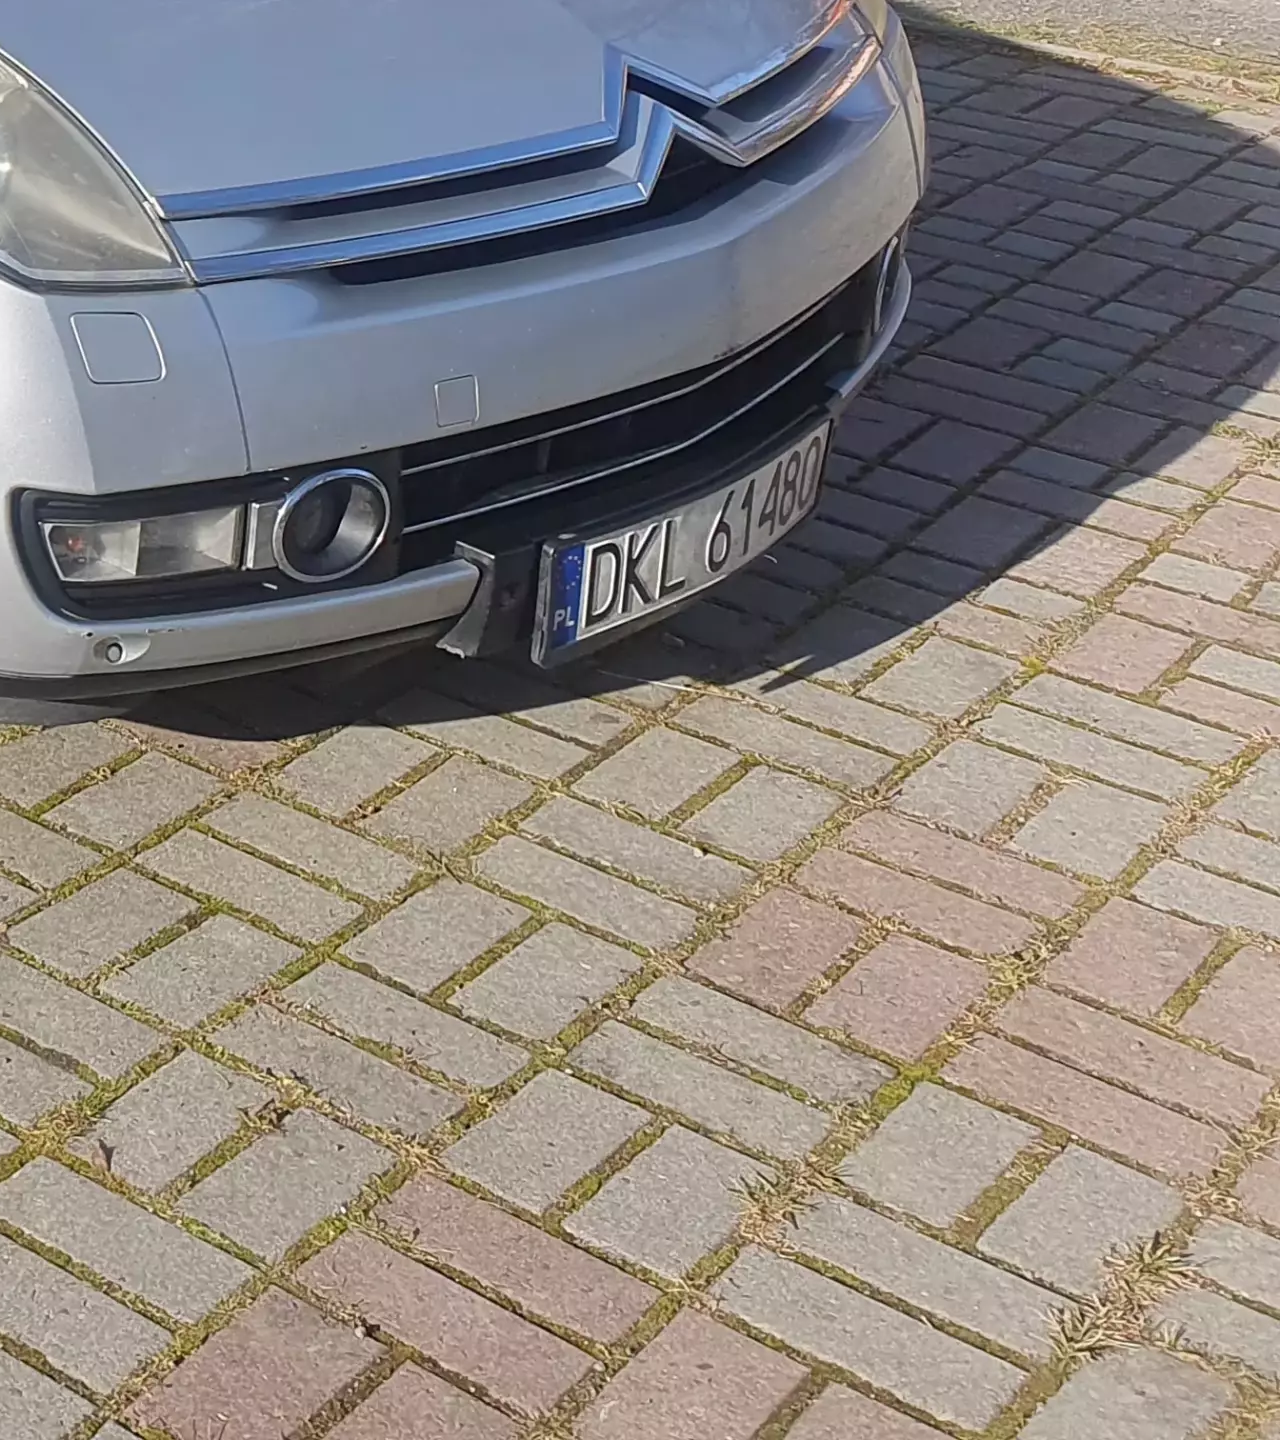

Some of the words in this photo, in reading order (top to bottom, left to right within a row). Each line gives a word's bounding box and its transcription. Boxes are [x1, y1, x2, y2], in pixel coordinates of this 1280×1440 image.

[583, 515, 686, 628] DKL
[705, 436, 822, 573] 61480
[552, 606, 575, 631] PL
